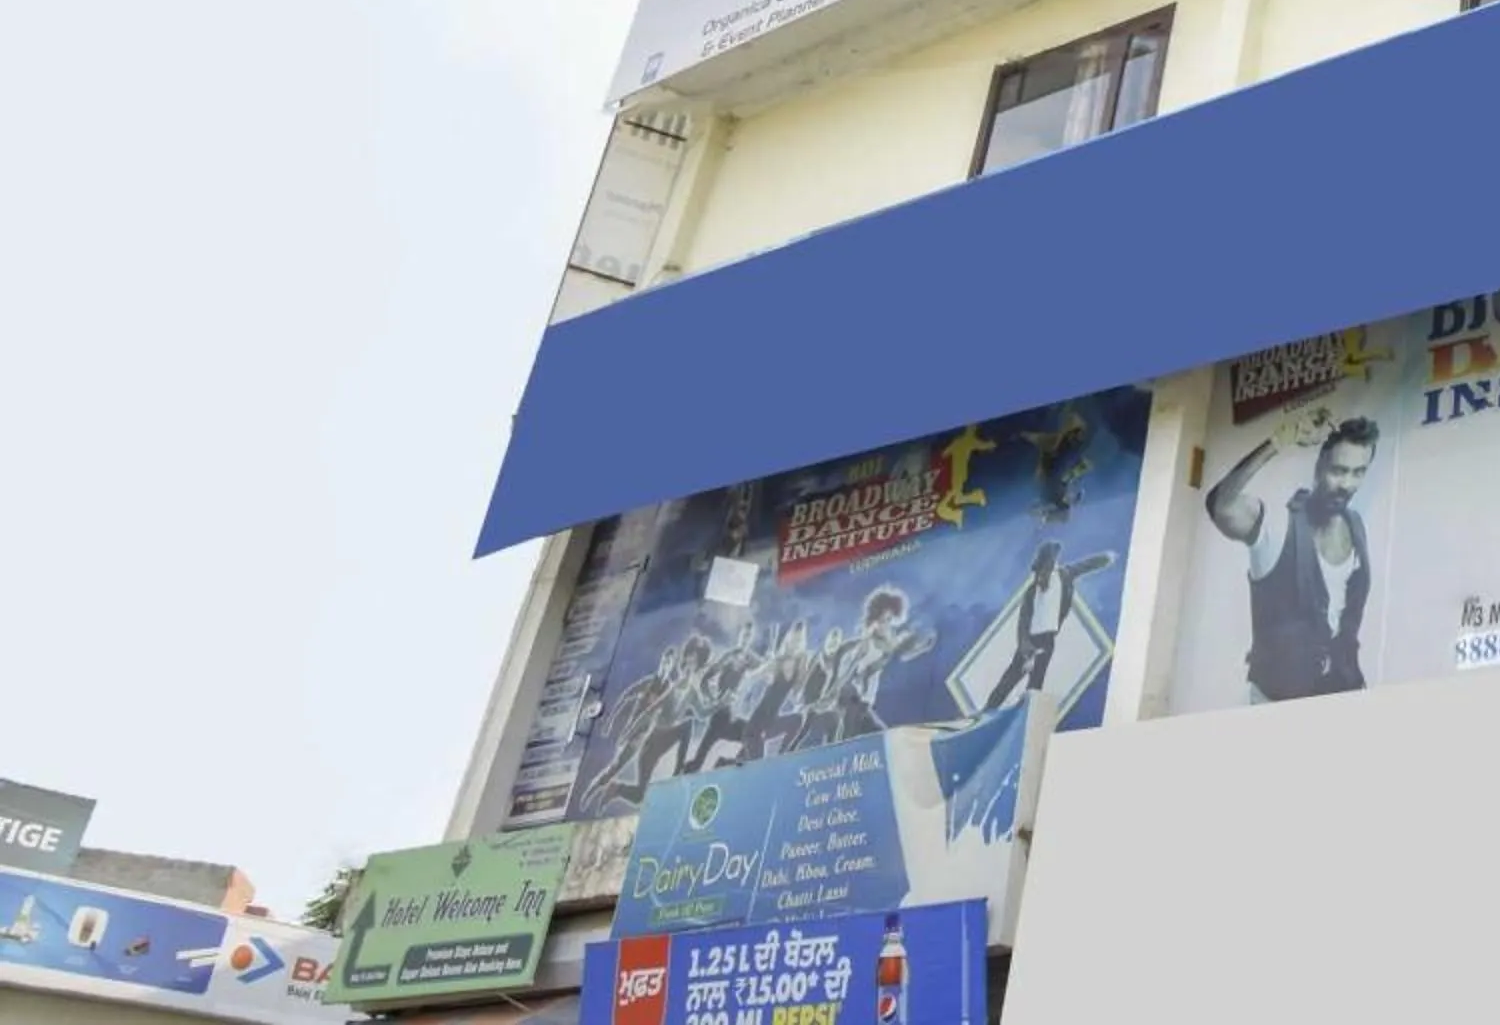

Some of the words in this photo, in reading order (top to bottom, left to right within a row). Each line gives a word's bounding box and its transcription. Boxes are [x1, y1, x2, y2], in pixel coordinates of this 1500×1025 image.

[716, 18, 765, 52] Event
[783, 493, 939, 544] DANCE
[790, 467, 941, 528] BROADWAY
[781, 513, 935, 563] INSTITUTE
[796, 758, 849, 787] Special
[633, 854, 705, 898] Dairy
[702, 842, 759, 888] Day
[381, 893, 430, 928] Hotel
[433, 888, 508, 923] Welcome
[514, 878, 547, 918] Inn
[772, 1001, 838, 1025] PEPSI
